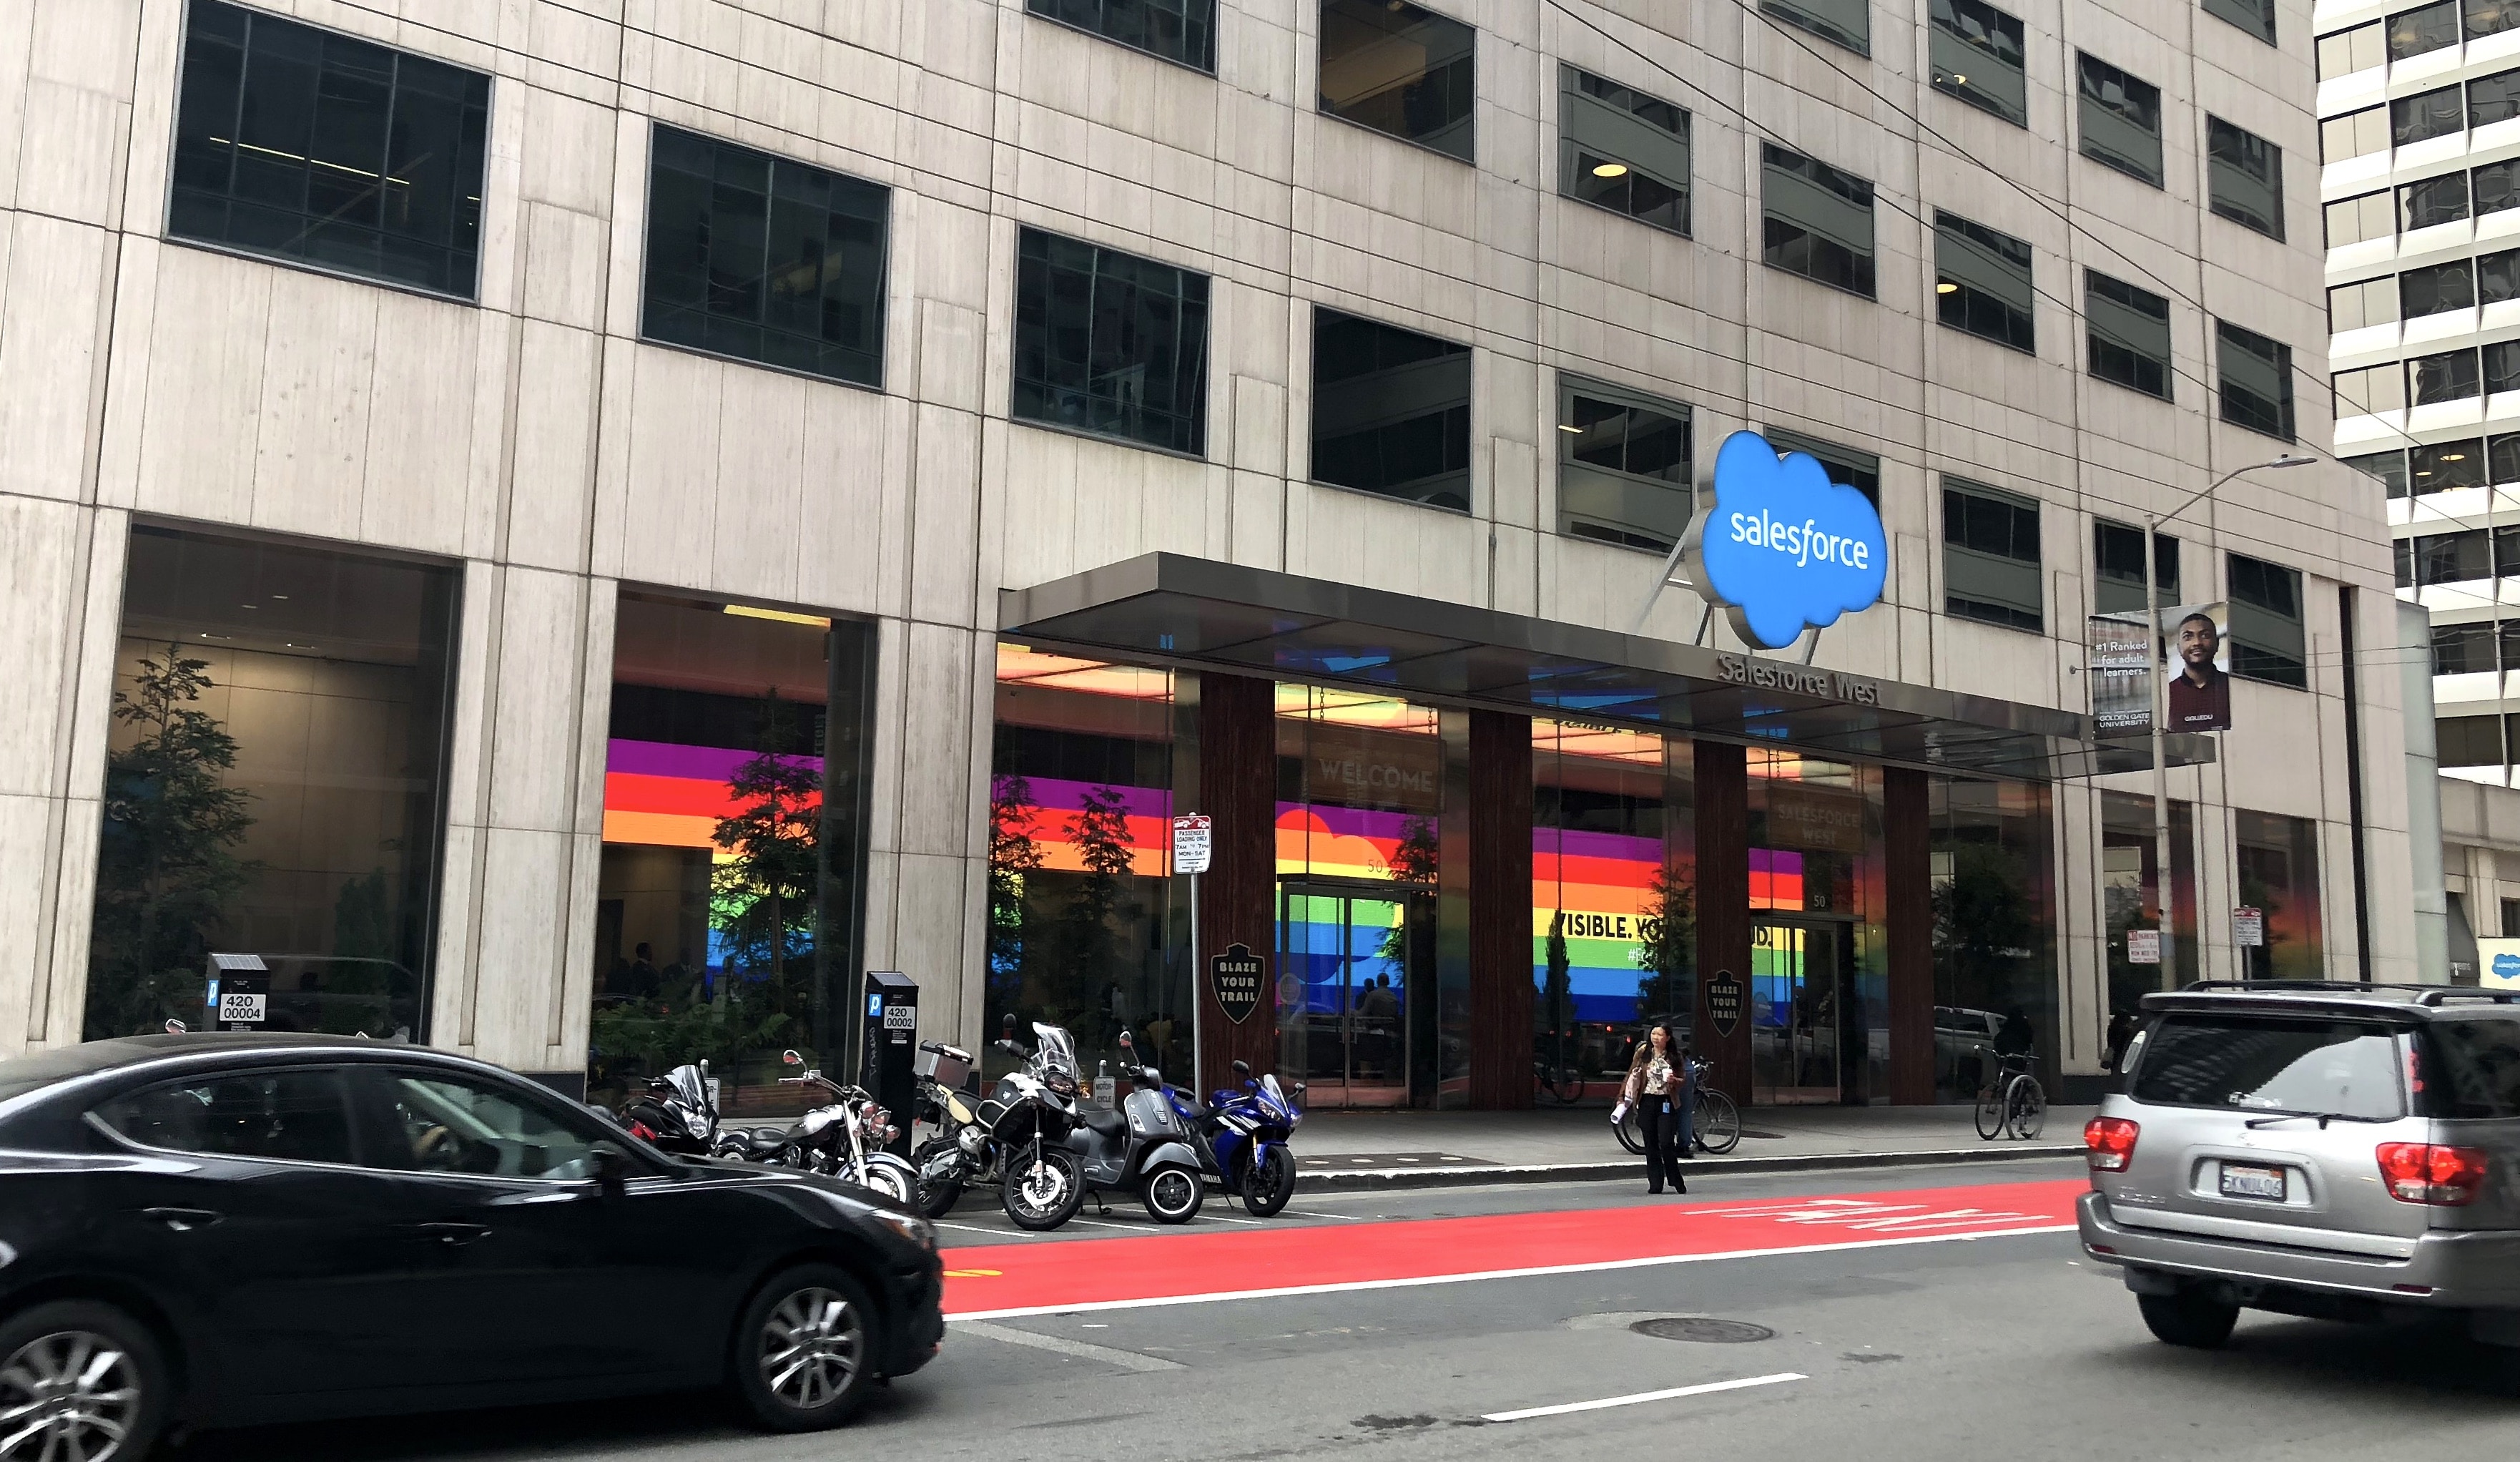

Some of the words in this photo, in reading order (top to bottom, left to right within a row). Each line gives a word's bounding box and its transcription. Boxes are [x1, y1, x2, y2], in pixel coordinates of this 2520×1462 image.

[1731, 509, 1869, 570] salesforce
[2095, 642, 2107, 652] #1
[2110, 639, 2147, 652] Ranked
[2101, 655, 2117, 665] for
[2119, 654, 2144, 664] adult
[2104, 667, 2147, 678] learners.
[1717, 652, 1829, 697] Salesforce
[1834, 673, 1883, 706] West
[2100, 718, 2150, 728] UNIVERSITY
[1319, 758, 1433, 793] WELCOME
[1778, 803, 1859, 828] SALESFORCE
[1803, 828, 1837, 844] WEST
[1368, 860, 1383, 873] 50
[1813, 896, 1826, 908] 50
[1219, 962, 1256, 972] BLAZE
[1221, 977, 1254, 987] YOUR
[1711, 986, 1738, 994] BLAZE
[227, 996, 253, 1007] 420
[1221, 992, 1255, 1001] TRAIL
[1713, 998, 1737, 1007] YOUR
[224, 1008, 260, 1019] 00004
[888, 1008, 907, 1017] 420
[1713, 1010, 1737, 1019] TRAIL
[887, 1018, 912, 1027] 00002
[1199, 1173, 1222, 1184] YAMAHA
